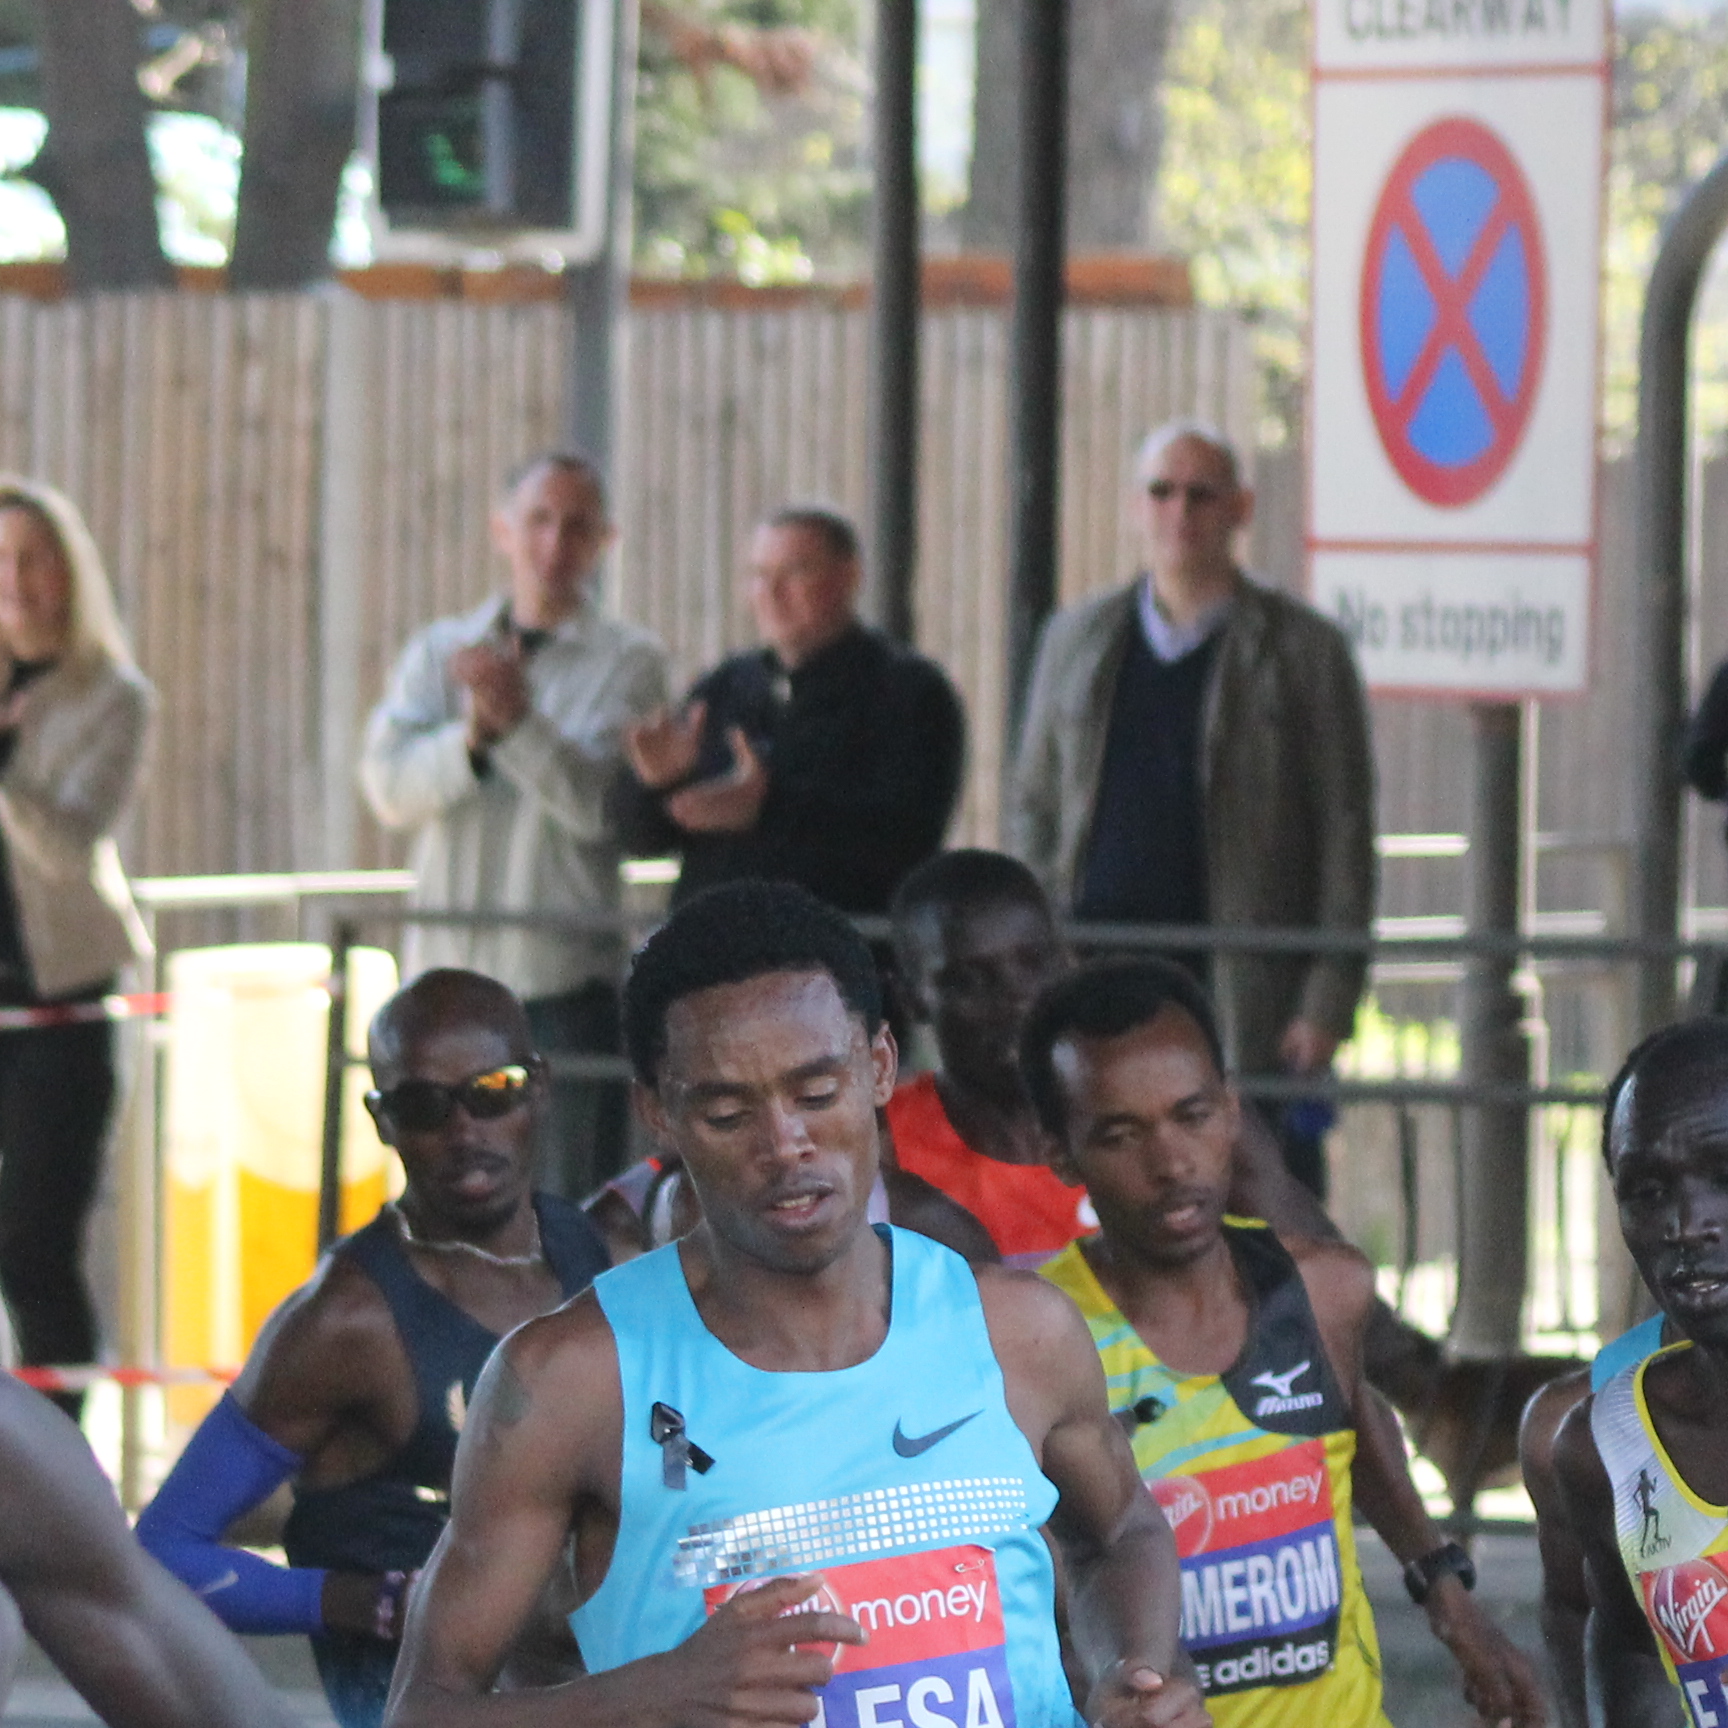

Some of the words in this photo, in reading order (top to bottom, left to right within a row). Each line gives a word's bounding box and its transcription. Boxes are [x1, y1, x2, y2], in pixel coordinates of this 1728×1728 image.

[1335, 586, 1386, 650] No
[1399, 588, 1566, 668] stopping
[1217, 1470, 1323, 1521] money
[852, 1580, 987, 1630] money
[1179, 1534, 1340, 1640] MEROM
[1659, 1565, 1728, 1655] Virgin
[1214, 1641, 1330, 1685] adidas
